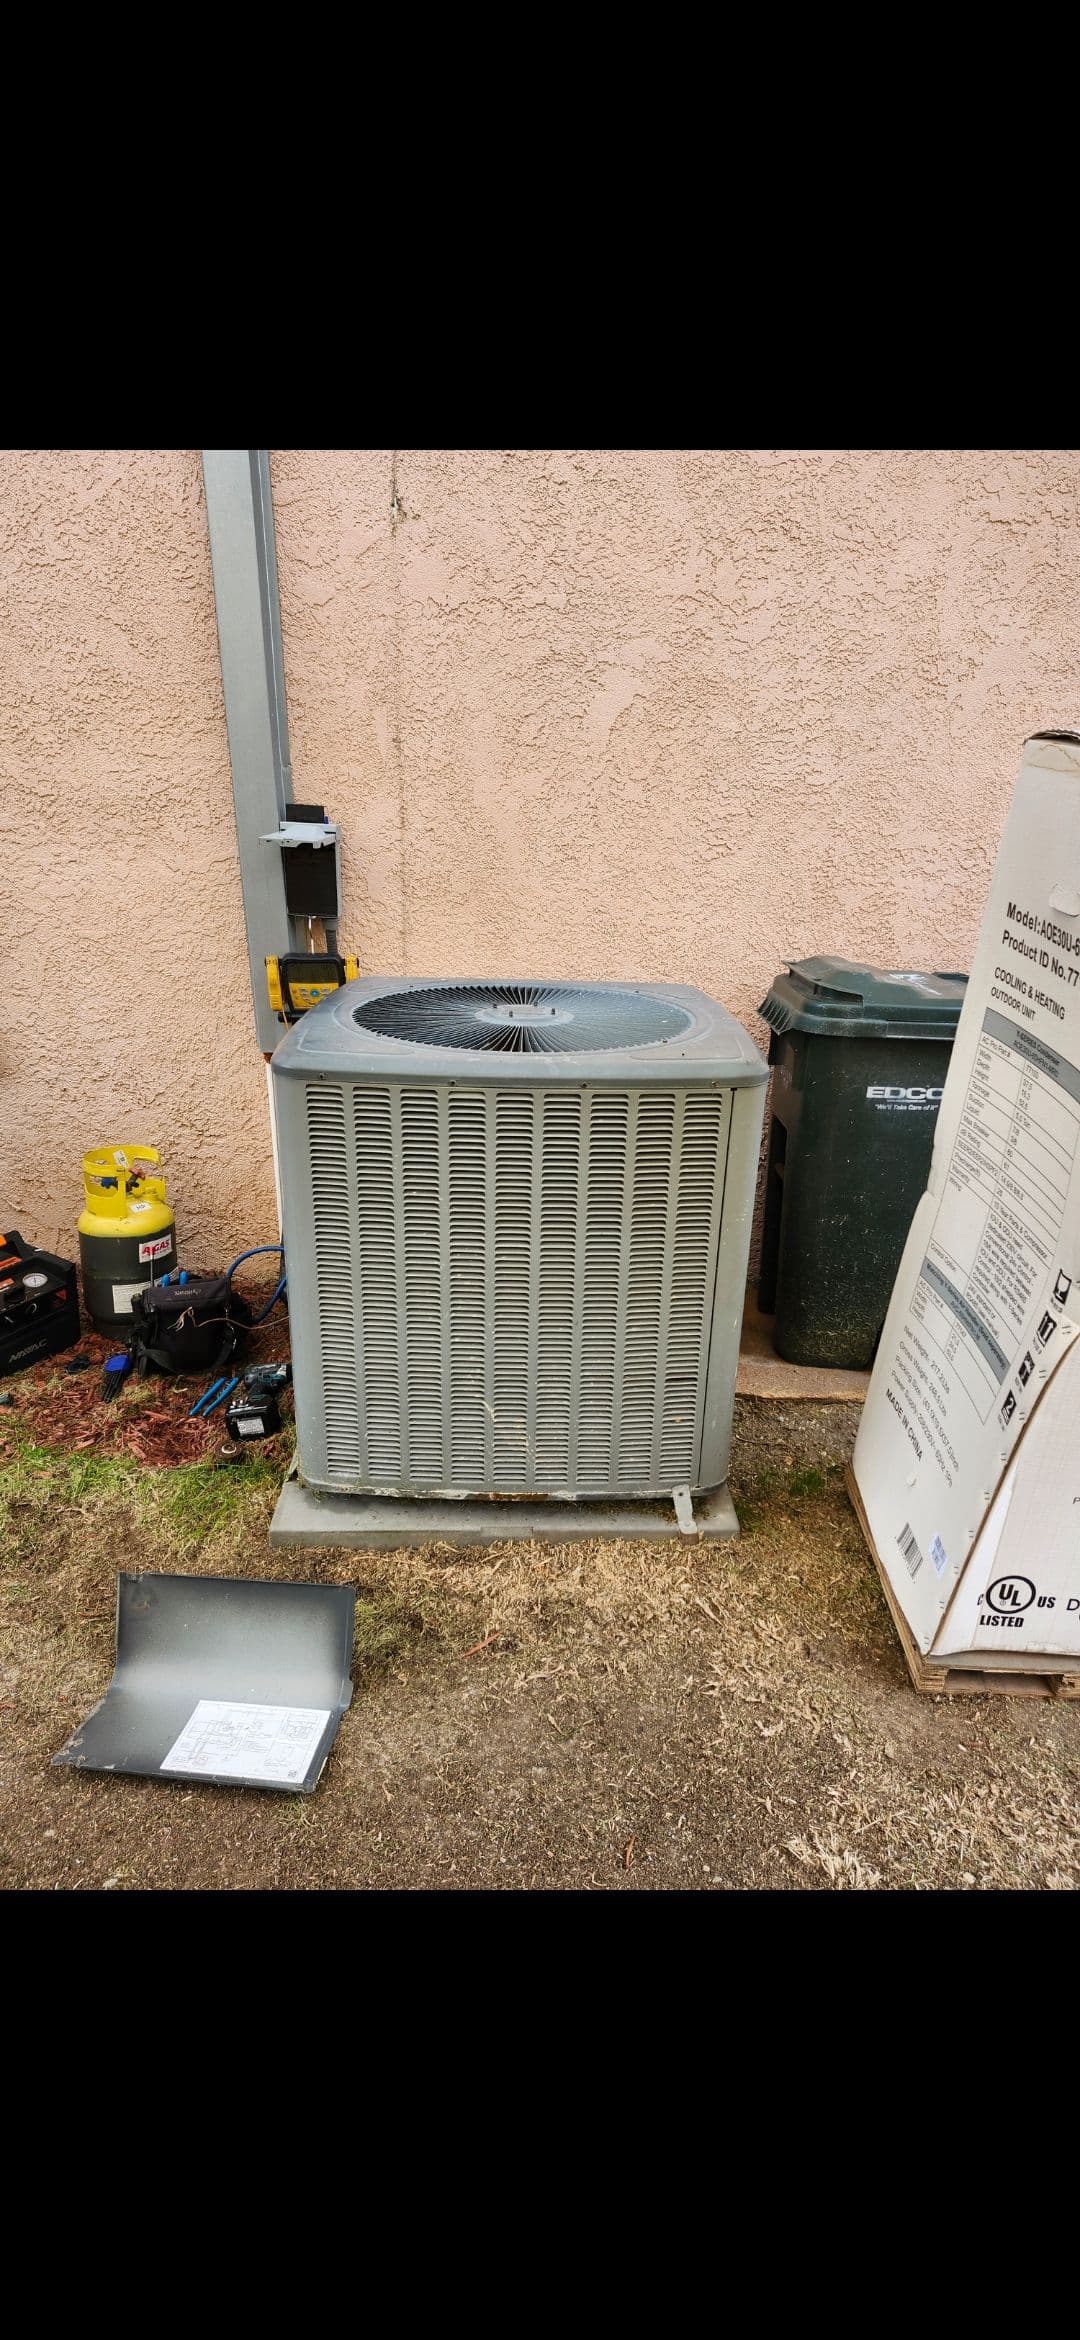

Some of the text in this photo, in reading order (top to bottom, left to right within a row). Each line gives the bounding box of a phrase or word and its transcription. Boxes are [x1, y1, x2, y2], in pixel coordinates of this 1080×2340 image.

[1002, 930, 1080, 987] Product ID No.77
[991, 987, 1036, 1021] OUTDOOR UNIT
[995, 967, 1065, 1020] COOLING & HEATING
[866, 1086, 944, 1100] EDCO
[886, 1388, 923, 1461] MADE IN CHINA
[1000, 1584, 1021, 1606] UL
[1038, 1596, 1056, 1608] US
[980, 1615, 1024, 1628] LISTED
